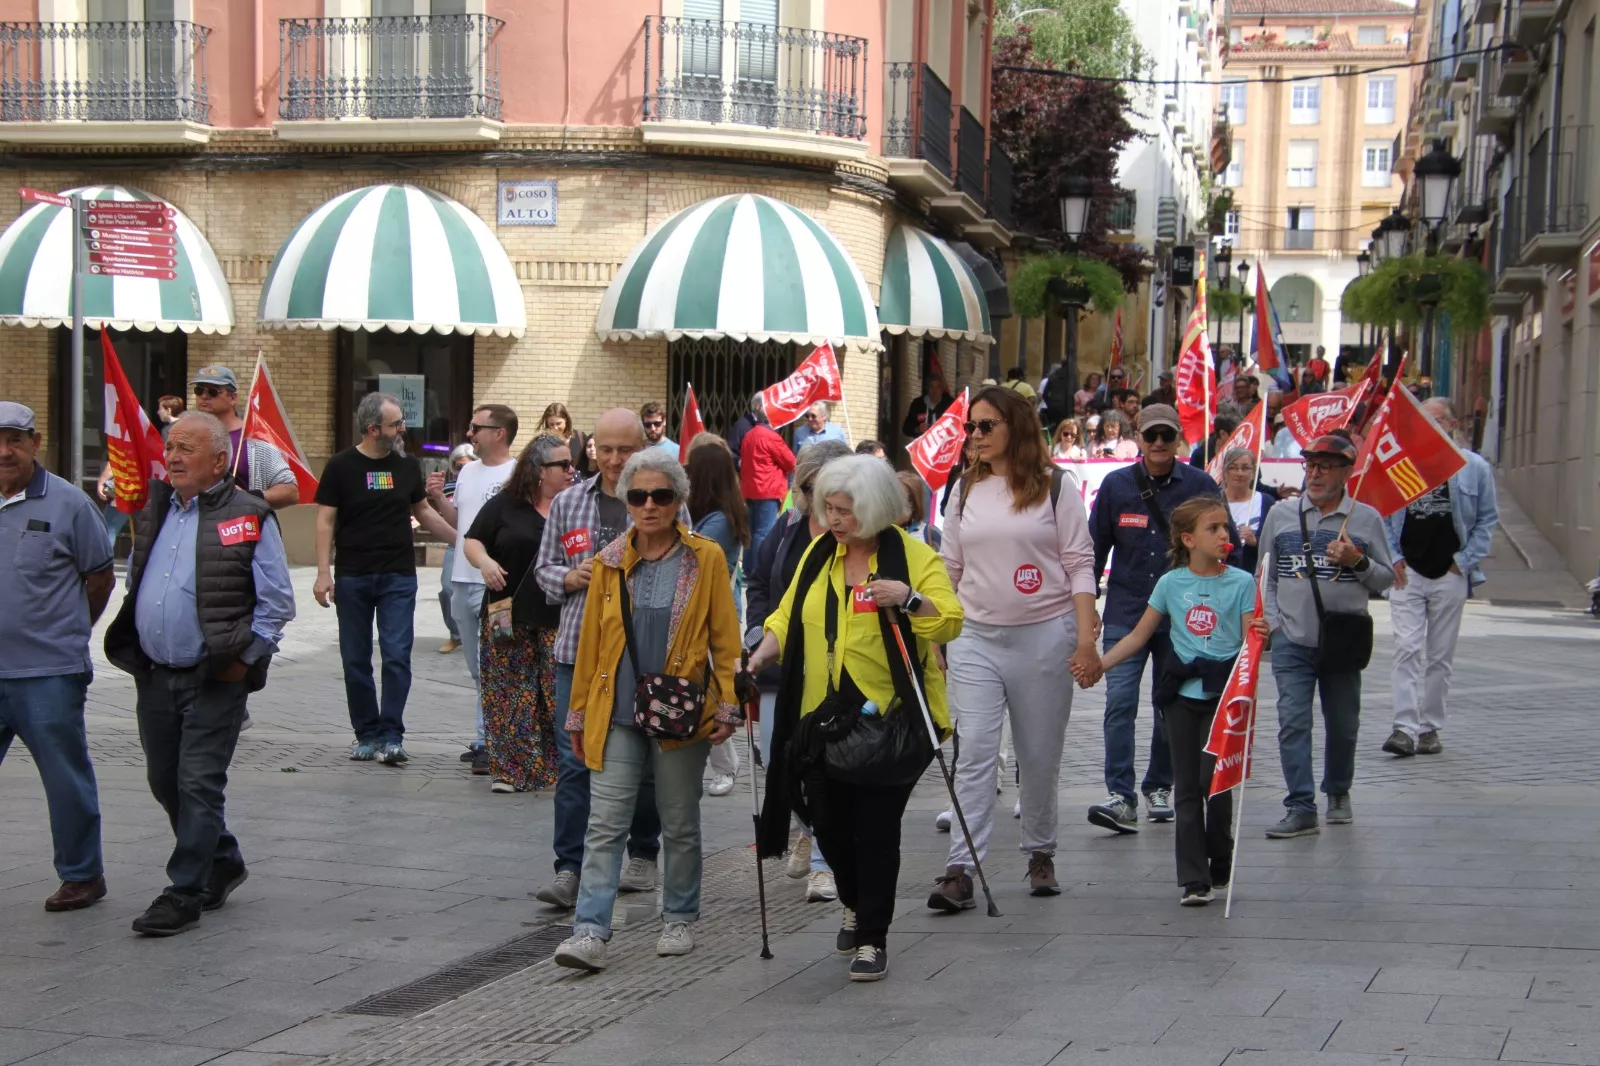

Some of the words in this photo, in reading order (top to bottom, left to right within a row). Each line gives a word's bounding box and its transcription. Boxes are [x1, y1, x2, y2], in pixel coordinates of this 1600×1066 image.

[518, 190, 547, 198] COSO
[506, 209, 549, 218] ALTO
[102, 255, 138, 264] Ayuntamiento
[120, 268, 145, 276] Histórico
[922, 417, 959, 463] UGT
[221, 523, 243, 536] UGT
[1018, 569, 1038, 581] UGT
[1190, 609, 1213, 624] UGT
